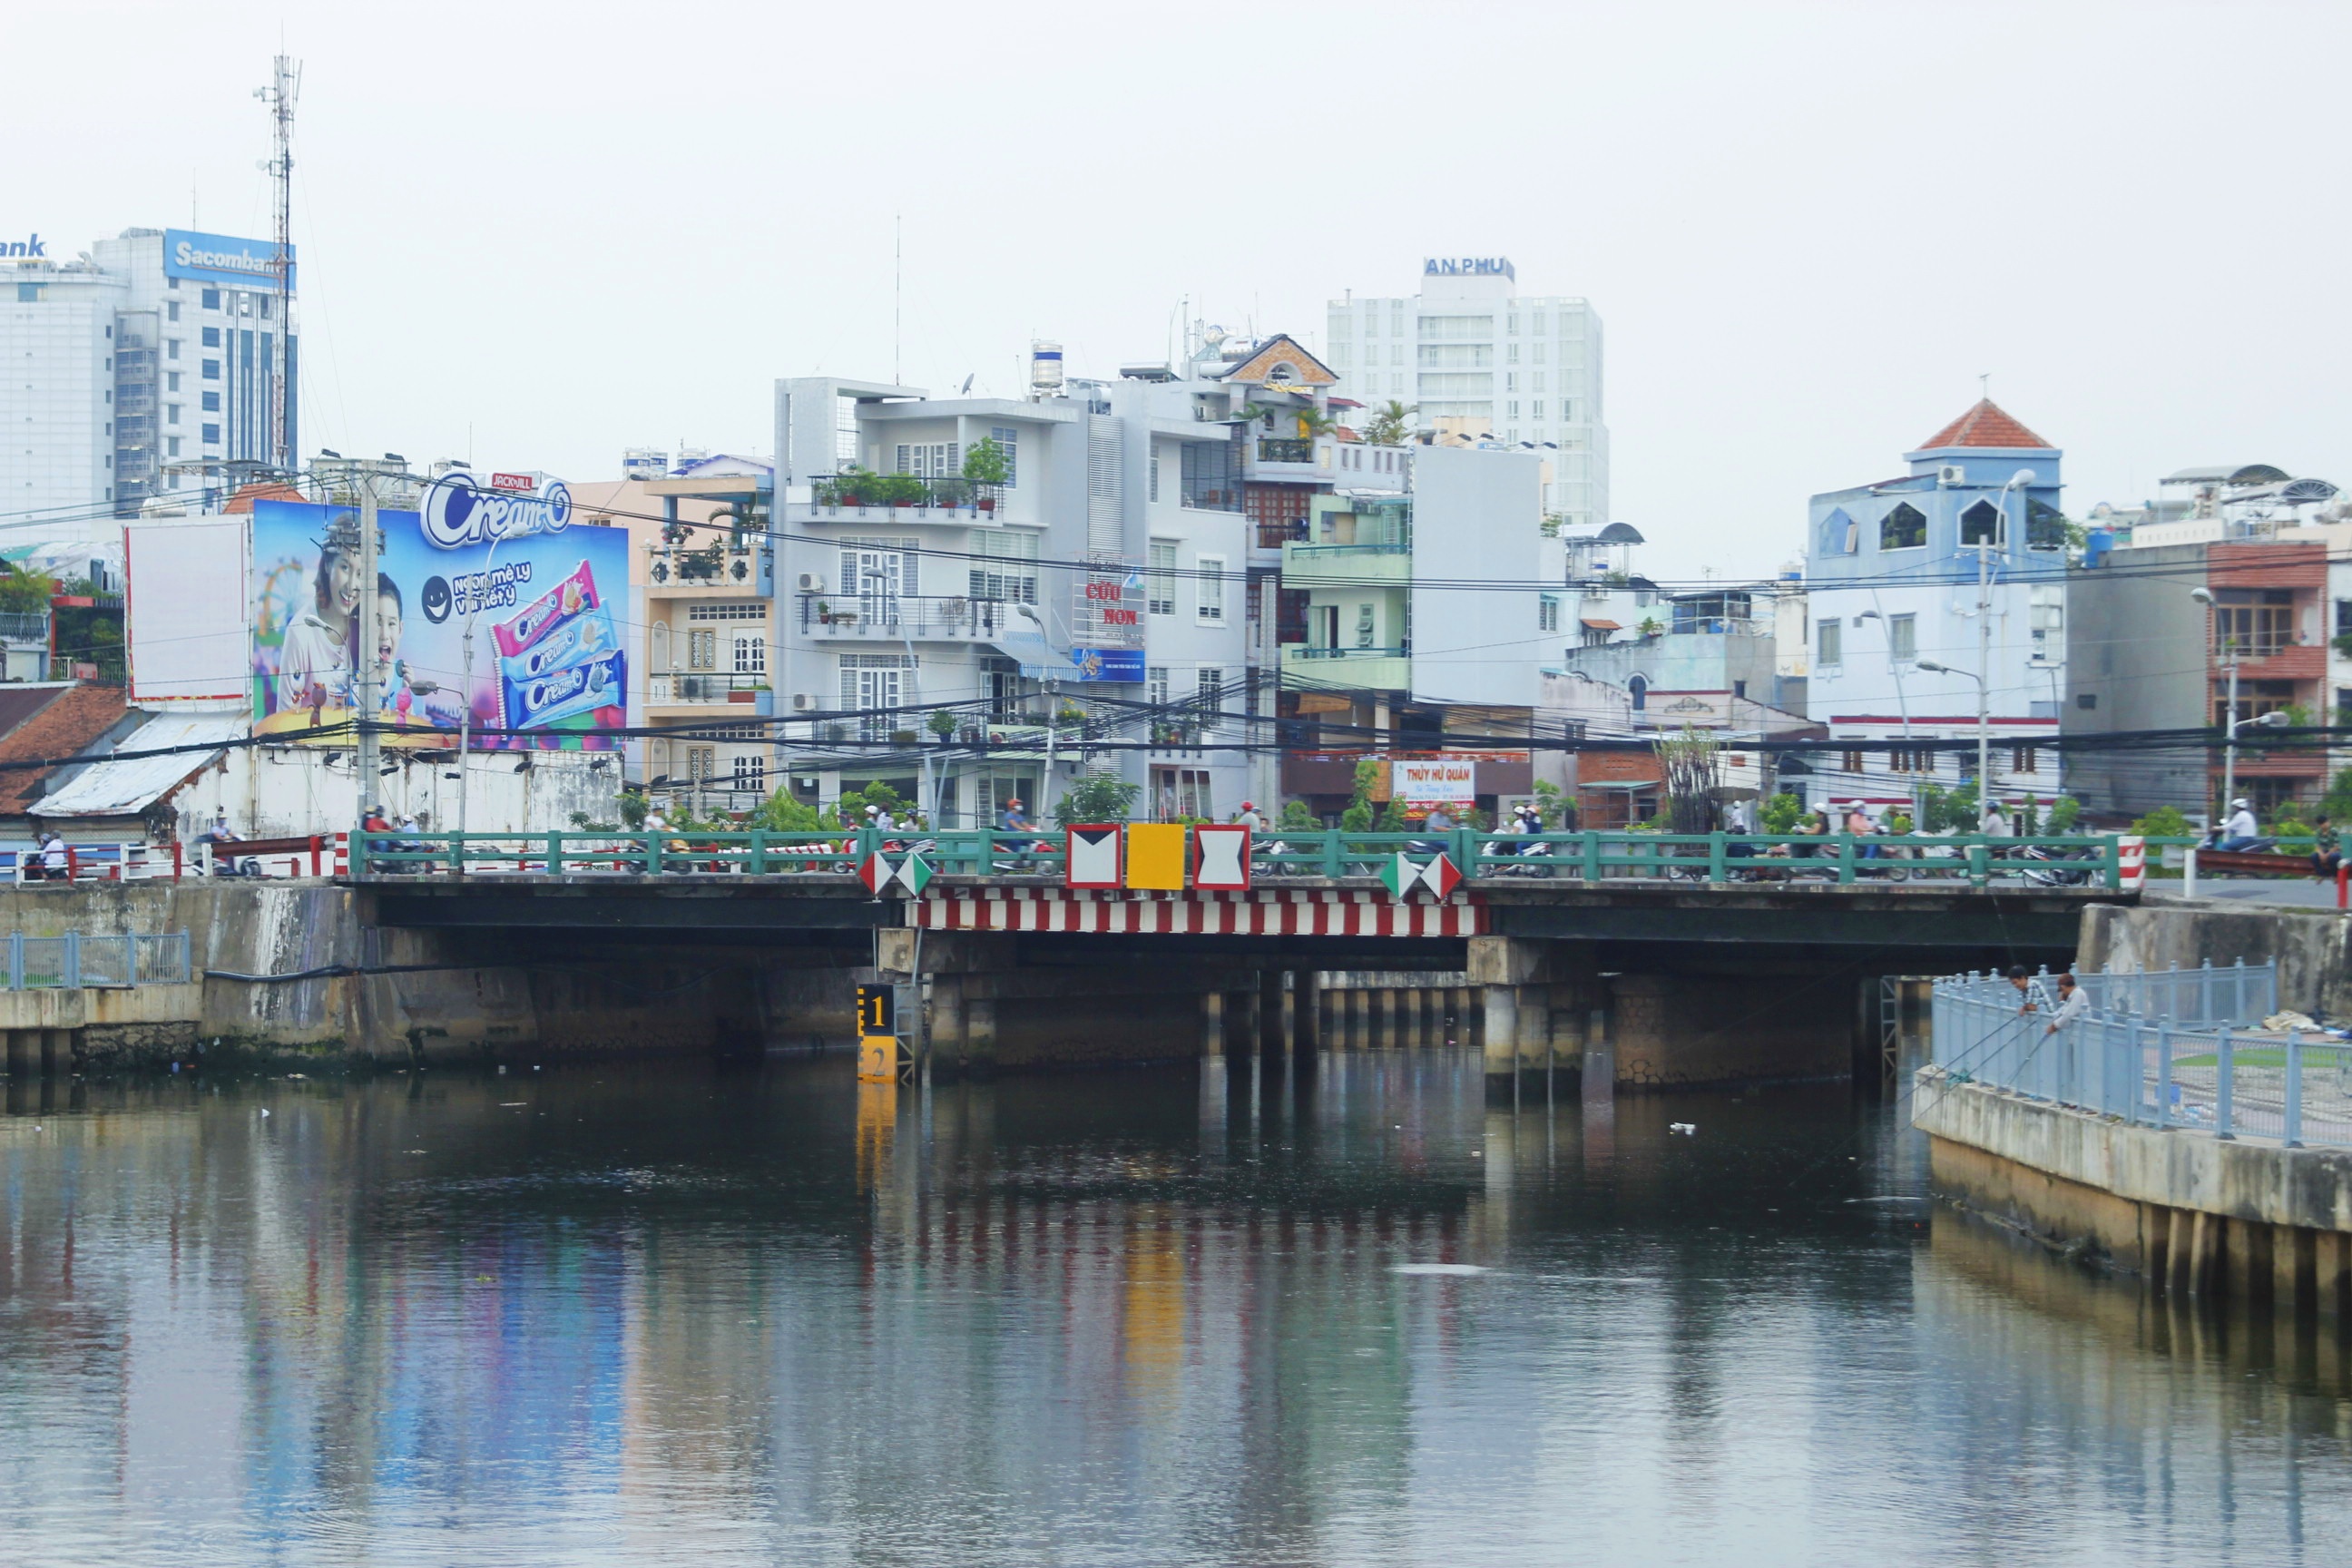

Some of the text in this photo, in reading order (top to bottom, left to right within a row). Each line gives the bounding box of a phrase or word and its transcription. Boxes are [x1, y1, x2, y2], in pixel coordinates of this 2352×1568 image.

[1425, 258, 1455, 274] AN
[1103, 608, 1137, 625] NON
[872, 995, 886, 1026] 1
[872, 1047, 886, 1076] 2
